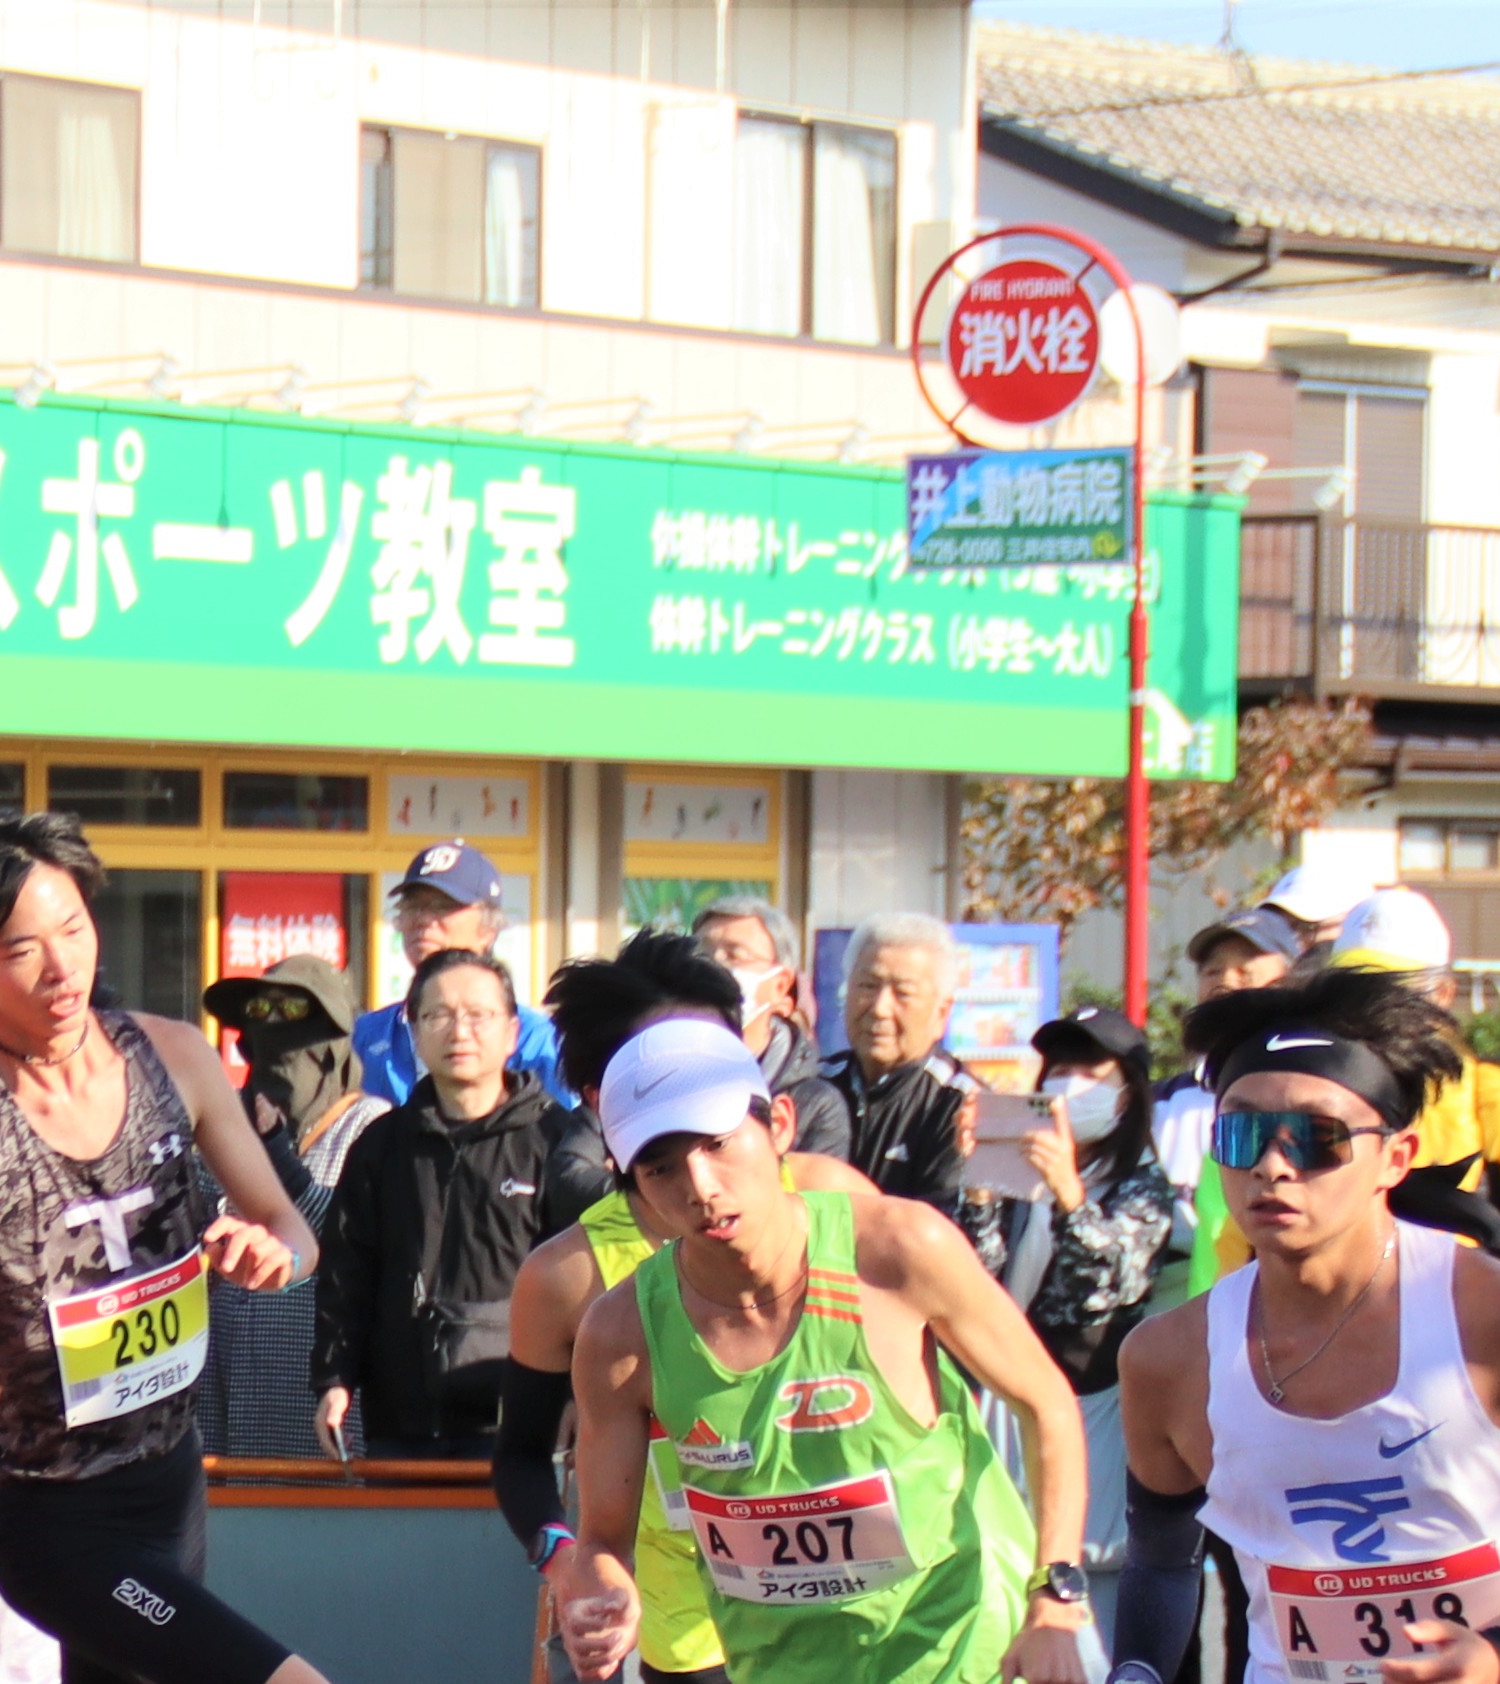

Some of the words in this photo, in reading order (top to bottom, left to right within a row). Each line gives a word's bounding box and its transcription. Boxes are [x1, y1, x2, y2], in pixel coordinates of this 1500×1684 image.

[970, 278, 1004, 302] FIRE
[1007, 275, 1076, 300] HYDRANT
[958, 304, 1092, 378] 消火栓
[910, 461, 1122, 532] 井上動物病院
[228, 912, 341, 968] 無料体験
[138, 1271, 182, 1298] TRUCKS
[110, 1298, 181, 1369] 230
[114, 1362, 190, 1409] アイダ設計
[755, 1503, 777, 1515] UD
[779, 1495, 840, 1513] TRUCKS
[706, 1521, 734, 1560] A
[762, 1515, 856, 1567] 207
[111, 1577, 177, 1626] 2XU
[758, 1576, 868, 1599] アイダ設計
[1349, 1576, 1373, 1589] UD
[1377, 1566, 1448, 1587] TRUCKS
[1288, 1605, 1318, 1654] A
